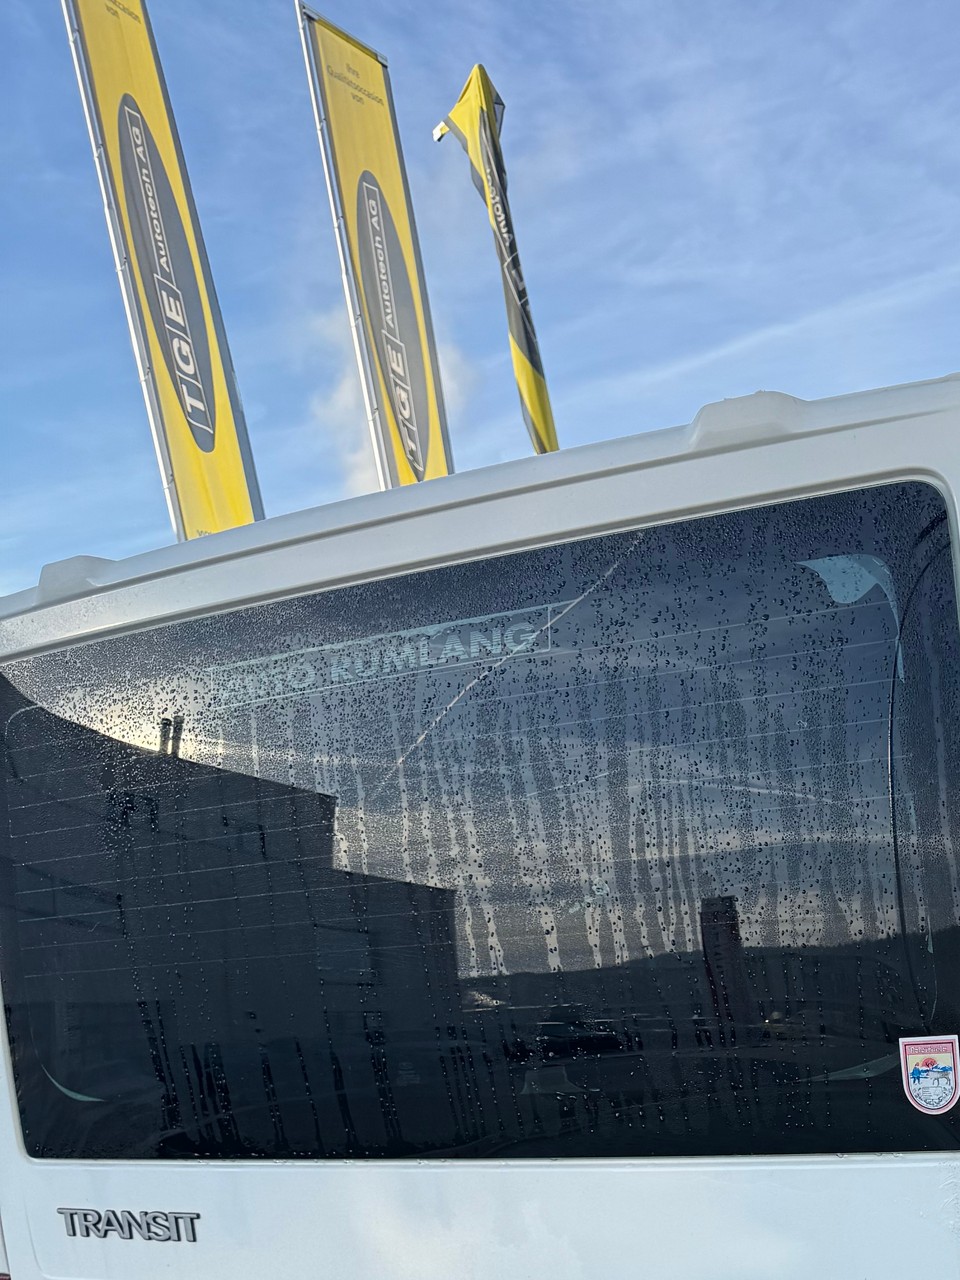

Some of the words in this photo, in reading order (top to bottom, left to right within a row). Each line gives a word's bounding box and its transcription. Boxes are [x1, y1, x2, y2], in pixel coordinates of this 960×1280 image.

[131, 126, 147, 163] AG
[142, 167, 171, 273] Autotech
[368, 199, 381, 231] AG
[374, 235, 395, 329] Autotech
[161, 290, 206, 413] TGE
[387, 343, 418, 453] TGE
[56, 1207, 201, 1242] TRANSIT
